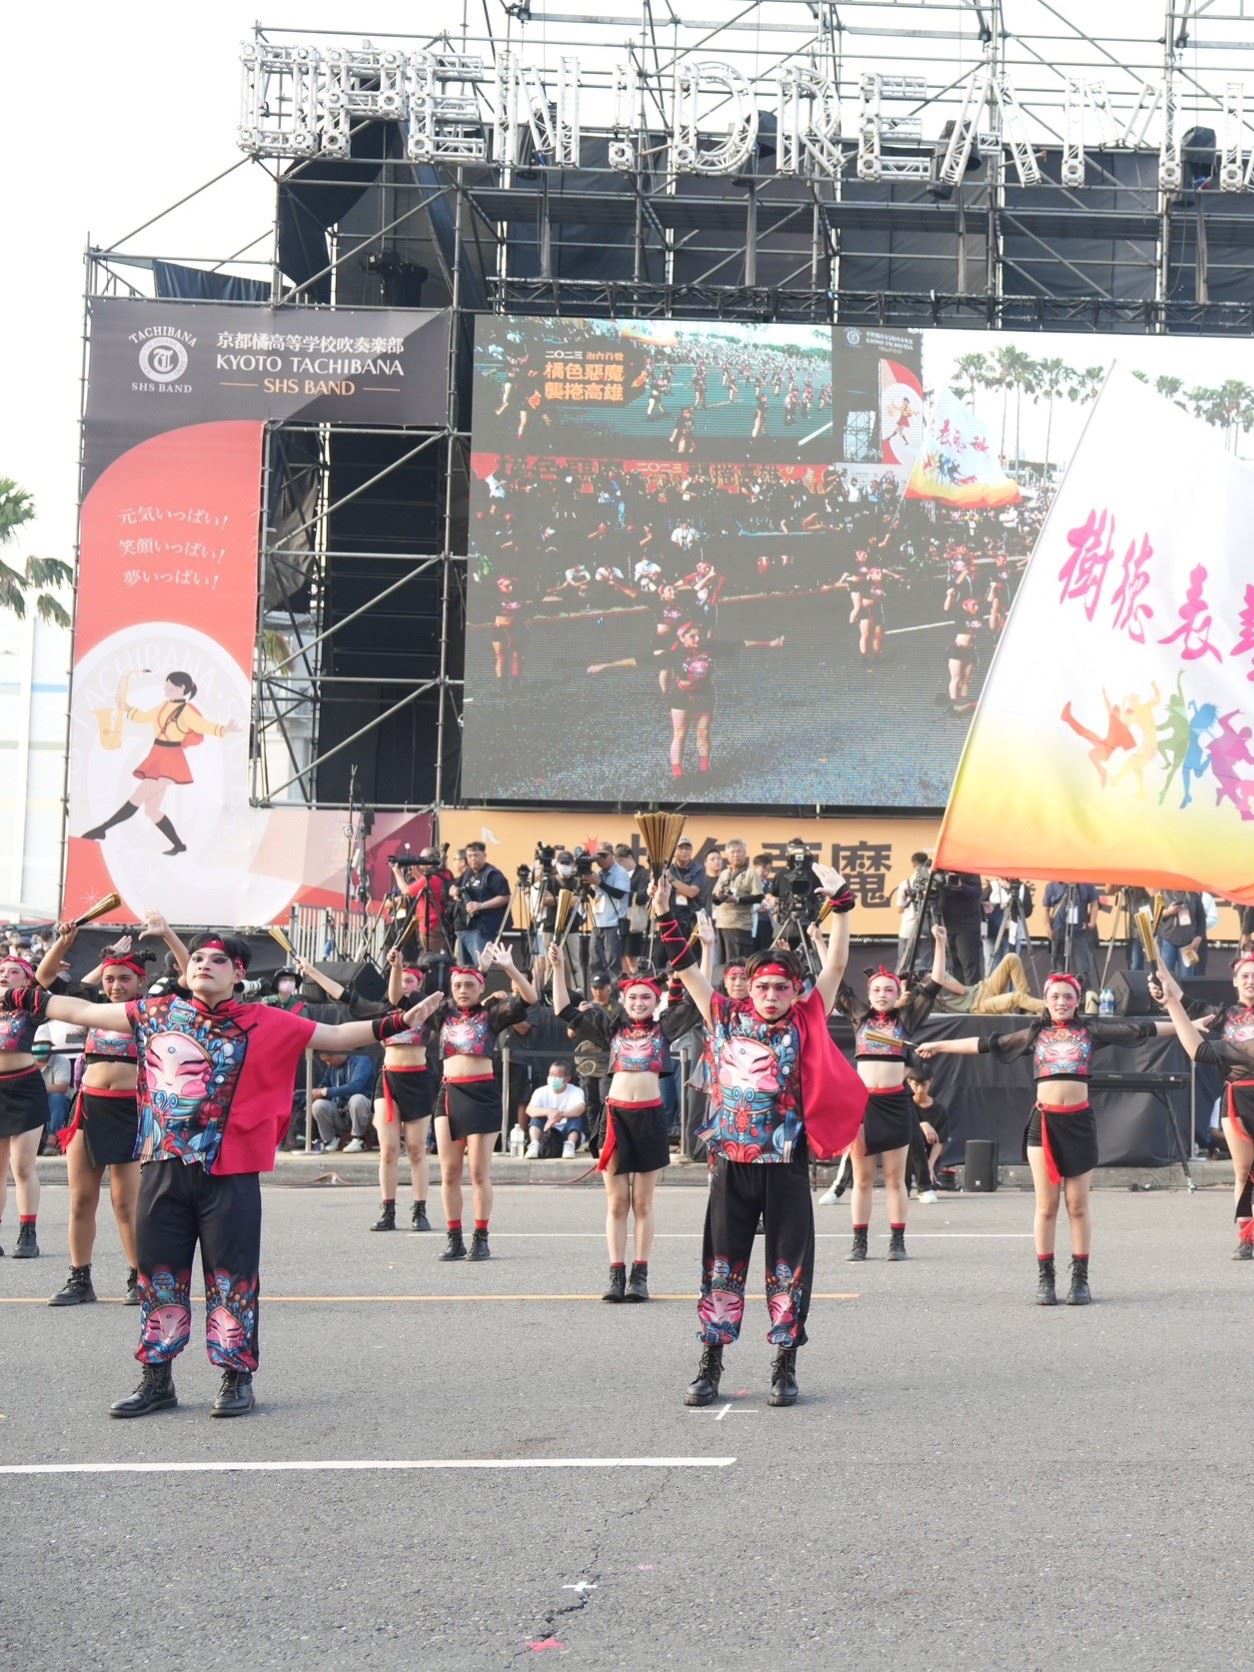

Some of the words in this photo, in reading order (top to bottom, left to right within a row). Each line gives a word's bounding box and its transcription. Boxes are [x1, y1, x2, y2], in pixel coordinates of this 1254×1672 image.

[128, 326, 197, 347] TACHIBANA
[216, 331, 404, 354] 京都橘高等学校吹奏楽部
[216, 354, 282, 373] KYOTO
[292, 356, 405, 377] TACHIBANA
[131, 382, 155, 392] SHS
[158, 383, 193, 393] BAND
[263, 378, 298, 394] SHS
[304, 380, 356, 396] BAND
